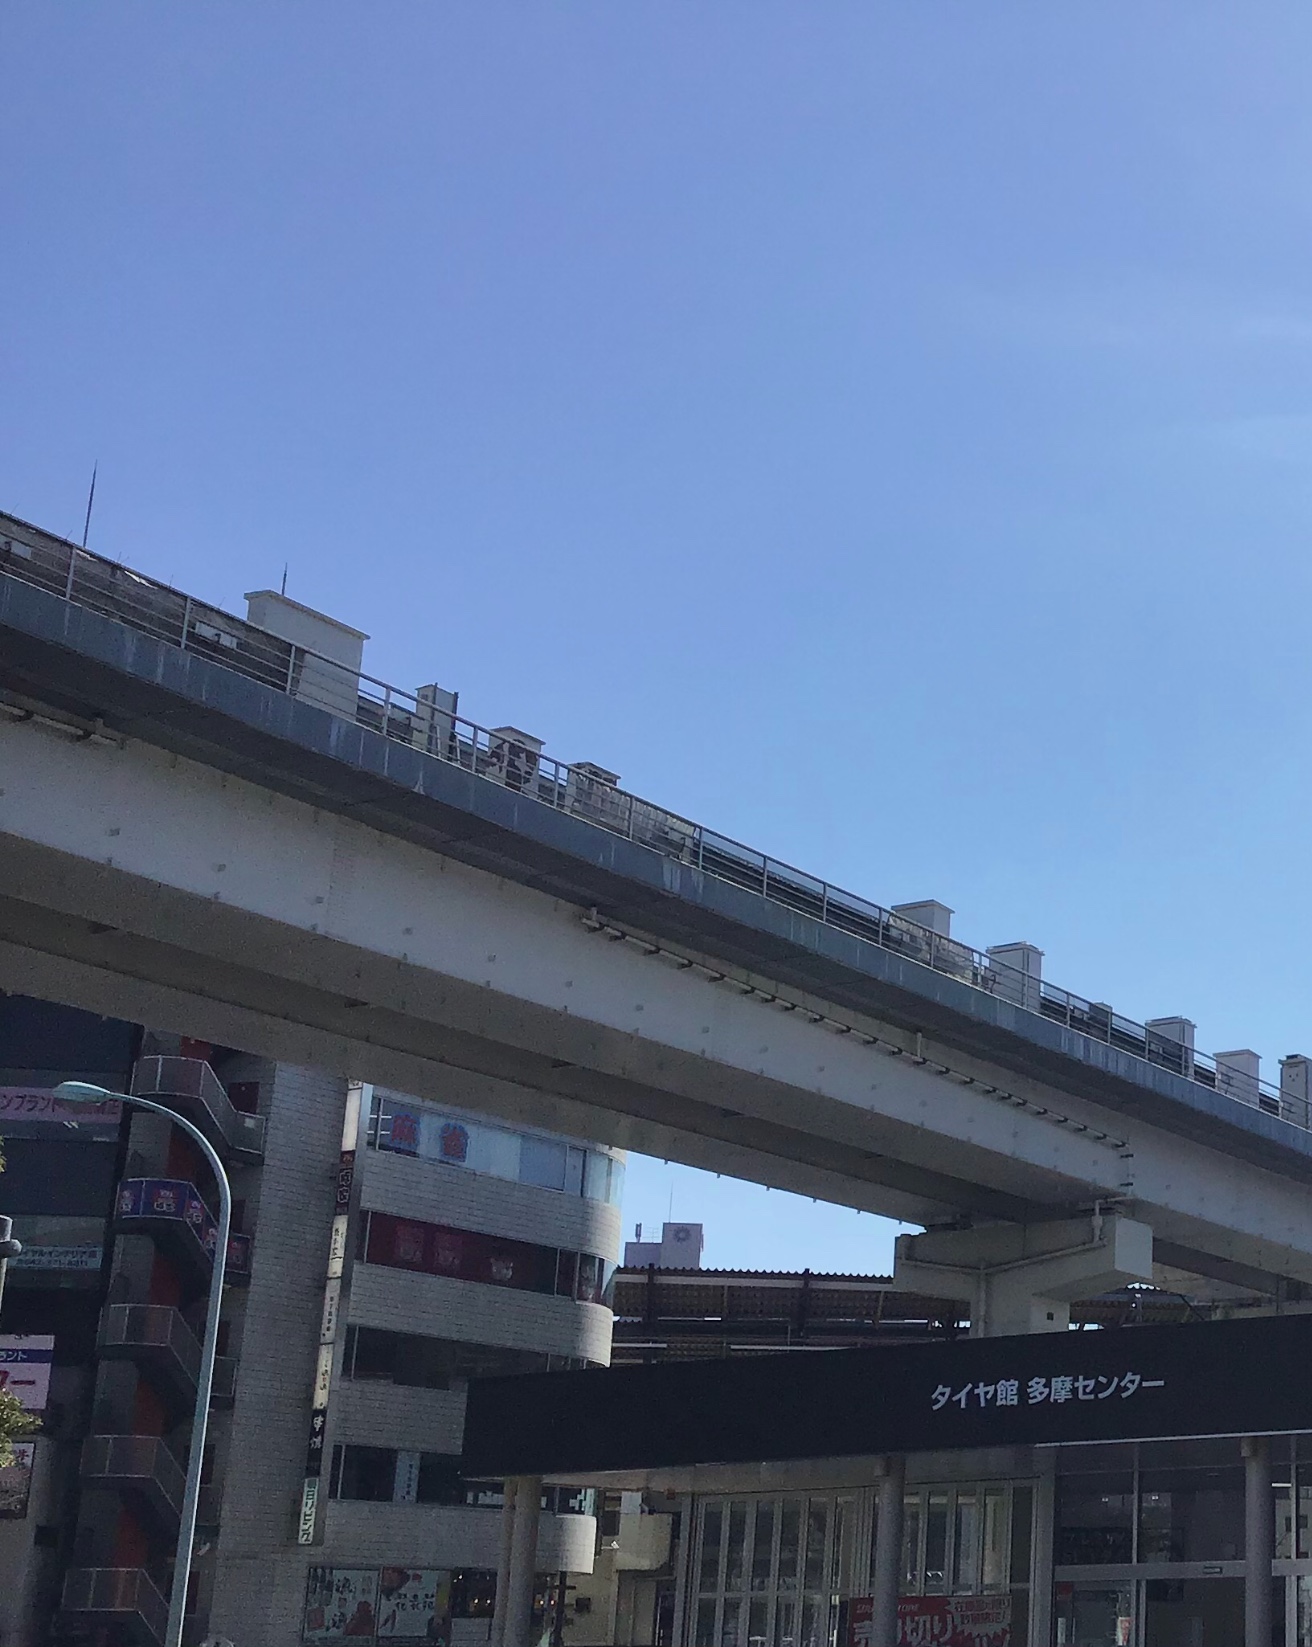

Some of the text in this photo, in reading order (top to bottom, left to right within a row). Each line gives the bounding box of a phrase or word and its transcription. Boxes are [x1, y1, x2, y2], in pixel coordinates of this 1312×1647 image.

[931, 1371, 1165, 1410] タイヤ館 多摩センター
